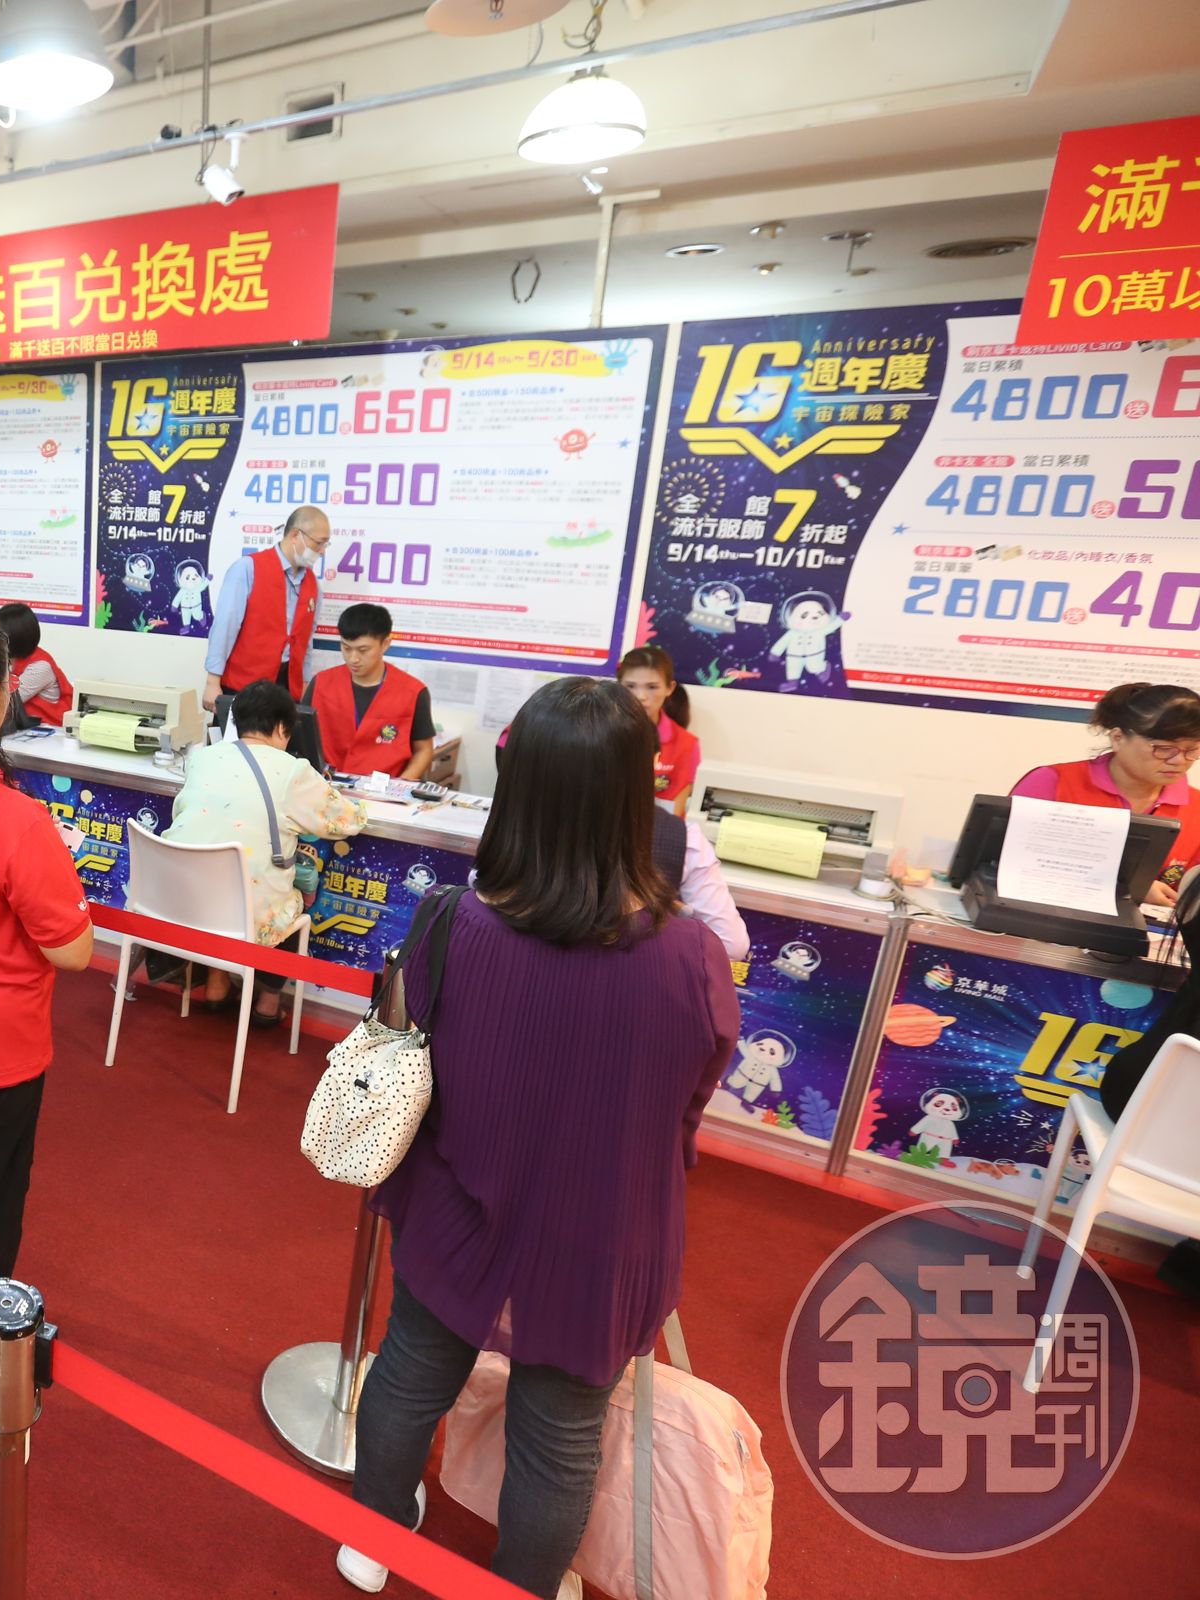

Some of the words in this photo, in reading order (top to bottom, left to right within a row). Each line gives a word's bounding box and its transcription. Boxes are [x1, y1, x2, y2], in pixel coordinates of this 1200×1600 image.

[1077, 155, 1200, 233] 滿
[451, 351, 495, 370] 9/14
[528, 349, 579, 369] 9/30
[811, 335, 935, 354] Anniversary
[173, 375, 238, 387] Anniversary
[684, 341, 802, 424] 16
[797, 353, 931, 394] 週年慶
[963, 359, 1023, 373] 當日累積
[108, 377, 168, 437] 16
[169, 387, 237, 416] 週年慶
[251, 403, 339, 436] 4800
[353, 387, 451, 434] 650
[951, 373, 1129, 421] 4800
[1023, 455, 1090, 467] 當日累積
[163, 485, 186, 524] 7
[244, 474, 330, 503] 4800
[343, 463, 440, 506] 500
[926, 474, 1095, 517] 4800
[108, 506, 161, 522] 流行服飾
[180, 510, 206, 525] 折起
[671, 517, 767, 540] 流行服飾
[799, 524, 848, 544] 折起
[773, 488, 817, 543] 7
[337, 541, 431, 586] 400
[903, 576, 1069, 623] 2800
[324, 871, 388, 903] 週年慶
[954, 976, 1008, 996] 京華城
